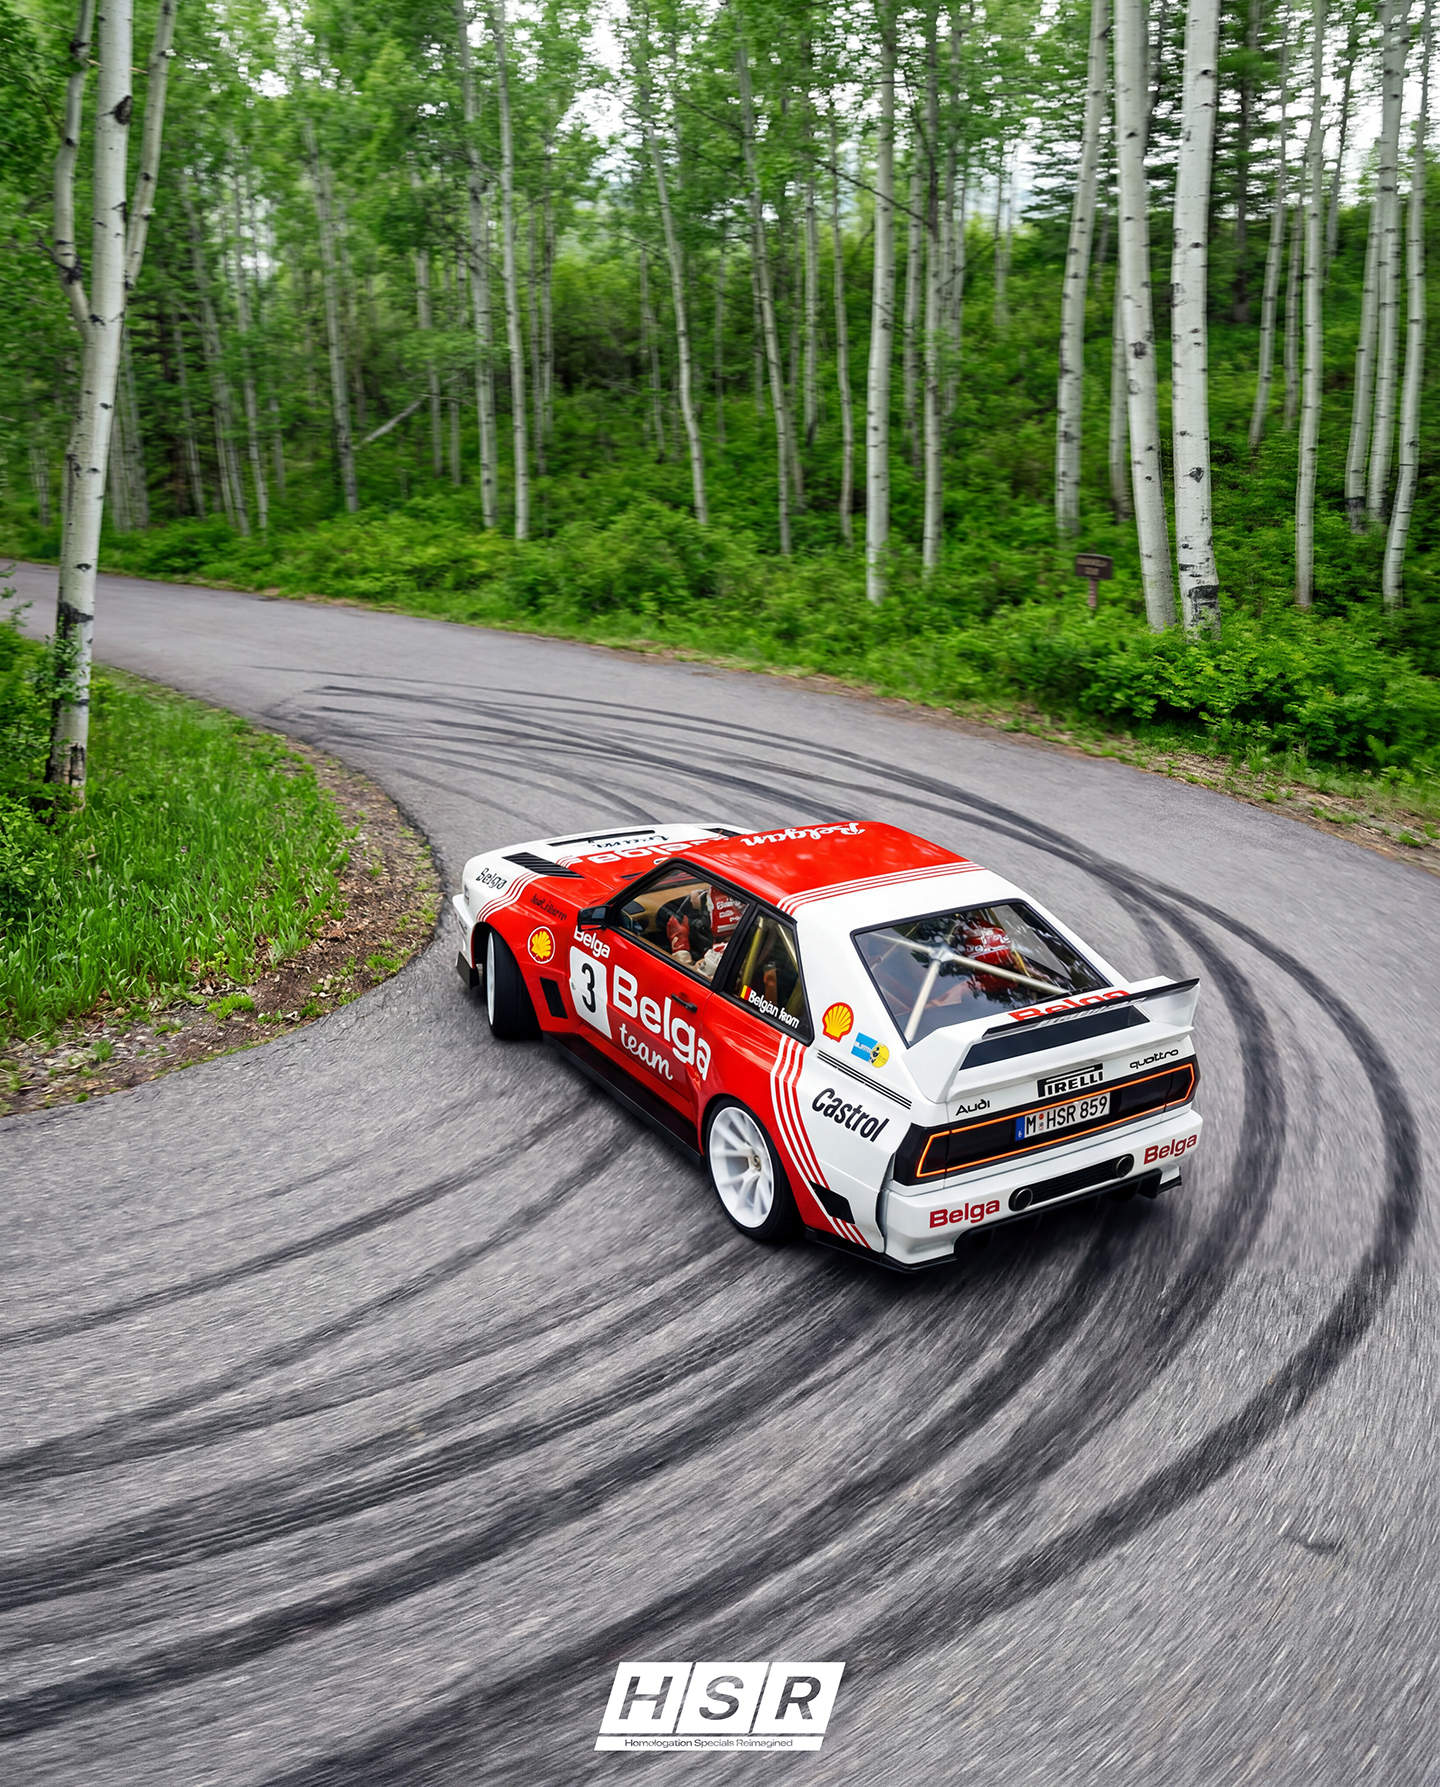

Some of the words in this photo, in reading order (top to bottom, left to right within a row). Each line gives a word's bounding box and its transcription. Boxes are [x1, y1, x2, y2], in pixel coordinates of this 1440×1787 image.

[475, 867, 508, 890] Belga
[581, 962, 597, 1014] 3
[613, 964, 712, 1081] Belga
[619, 1023, 674, 1081] team
[1129, 1048, 1179, 1070] quattro
[1037, 1062, 1104, 1098] PIRELLI
[811, 1087, 891, 1143] Castrol
[955, 1098, 991, 1117] Audi
[1026, 1114, 1037, 1136] M
[1046, 1104, 1077, 1130] HSR
[1080, 1095, 1108, 1119] 859
[1143, 1133, 1198, 1165] Belga
[929, 1199, 1001, 1229] Belga
